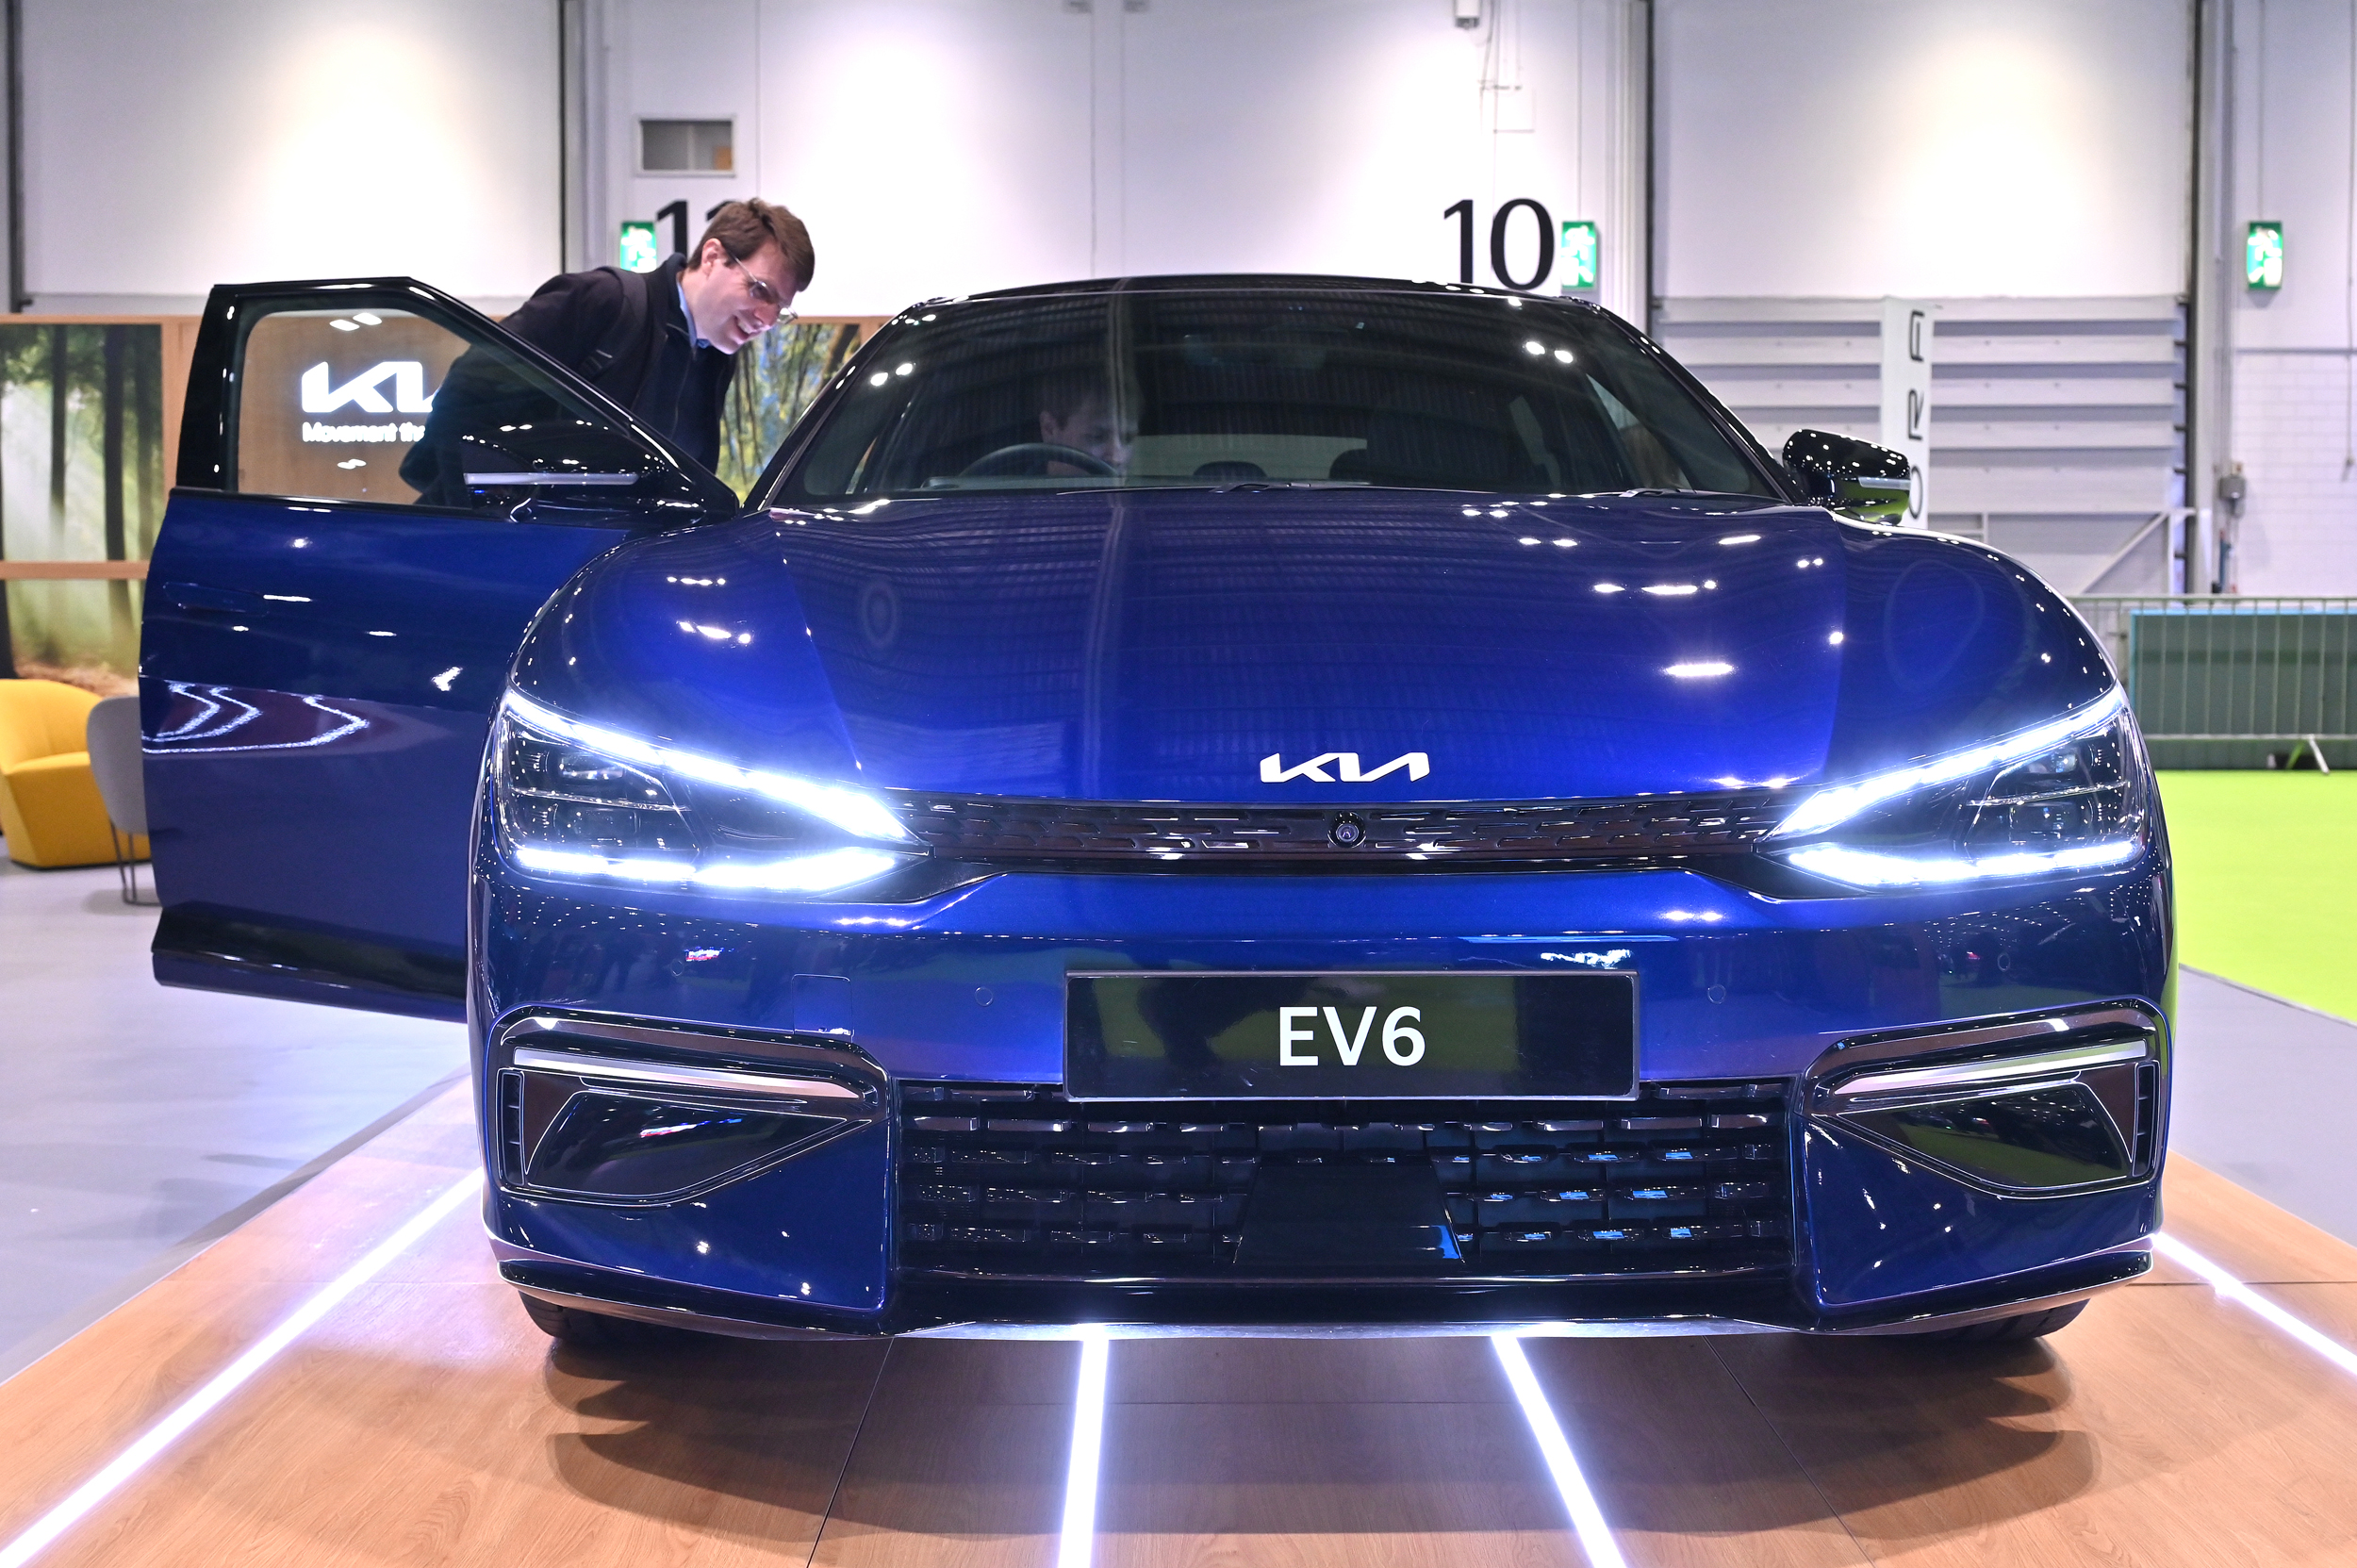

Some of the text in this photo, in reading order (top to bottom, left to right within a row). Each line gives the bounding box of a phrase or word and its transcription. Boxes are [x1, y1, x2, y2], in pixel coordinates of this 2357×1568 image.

[656, 199, 736, 261] 1
[1443, 198, 1555, 290] 10
[302, 421, 398, 442] Movement
[1260, 751, 1430, 783] KIA
[1279, 1005, 1426, 1067] EV6
